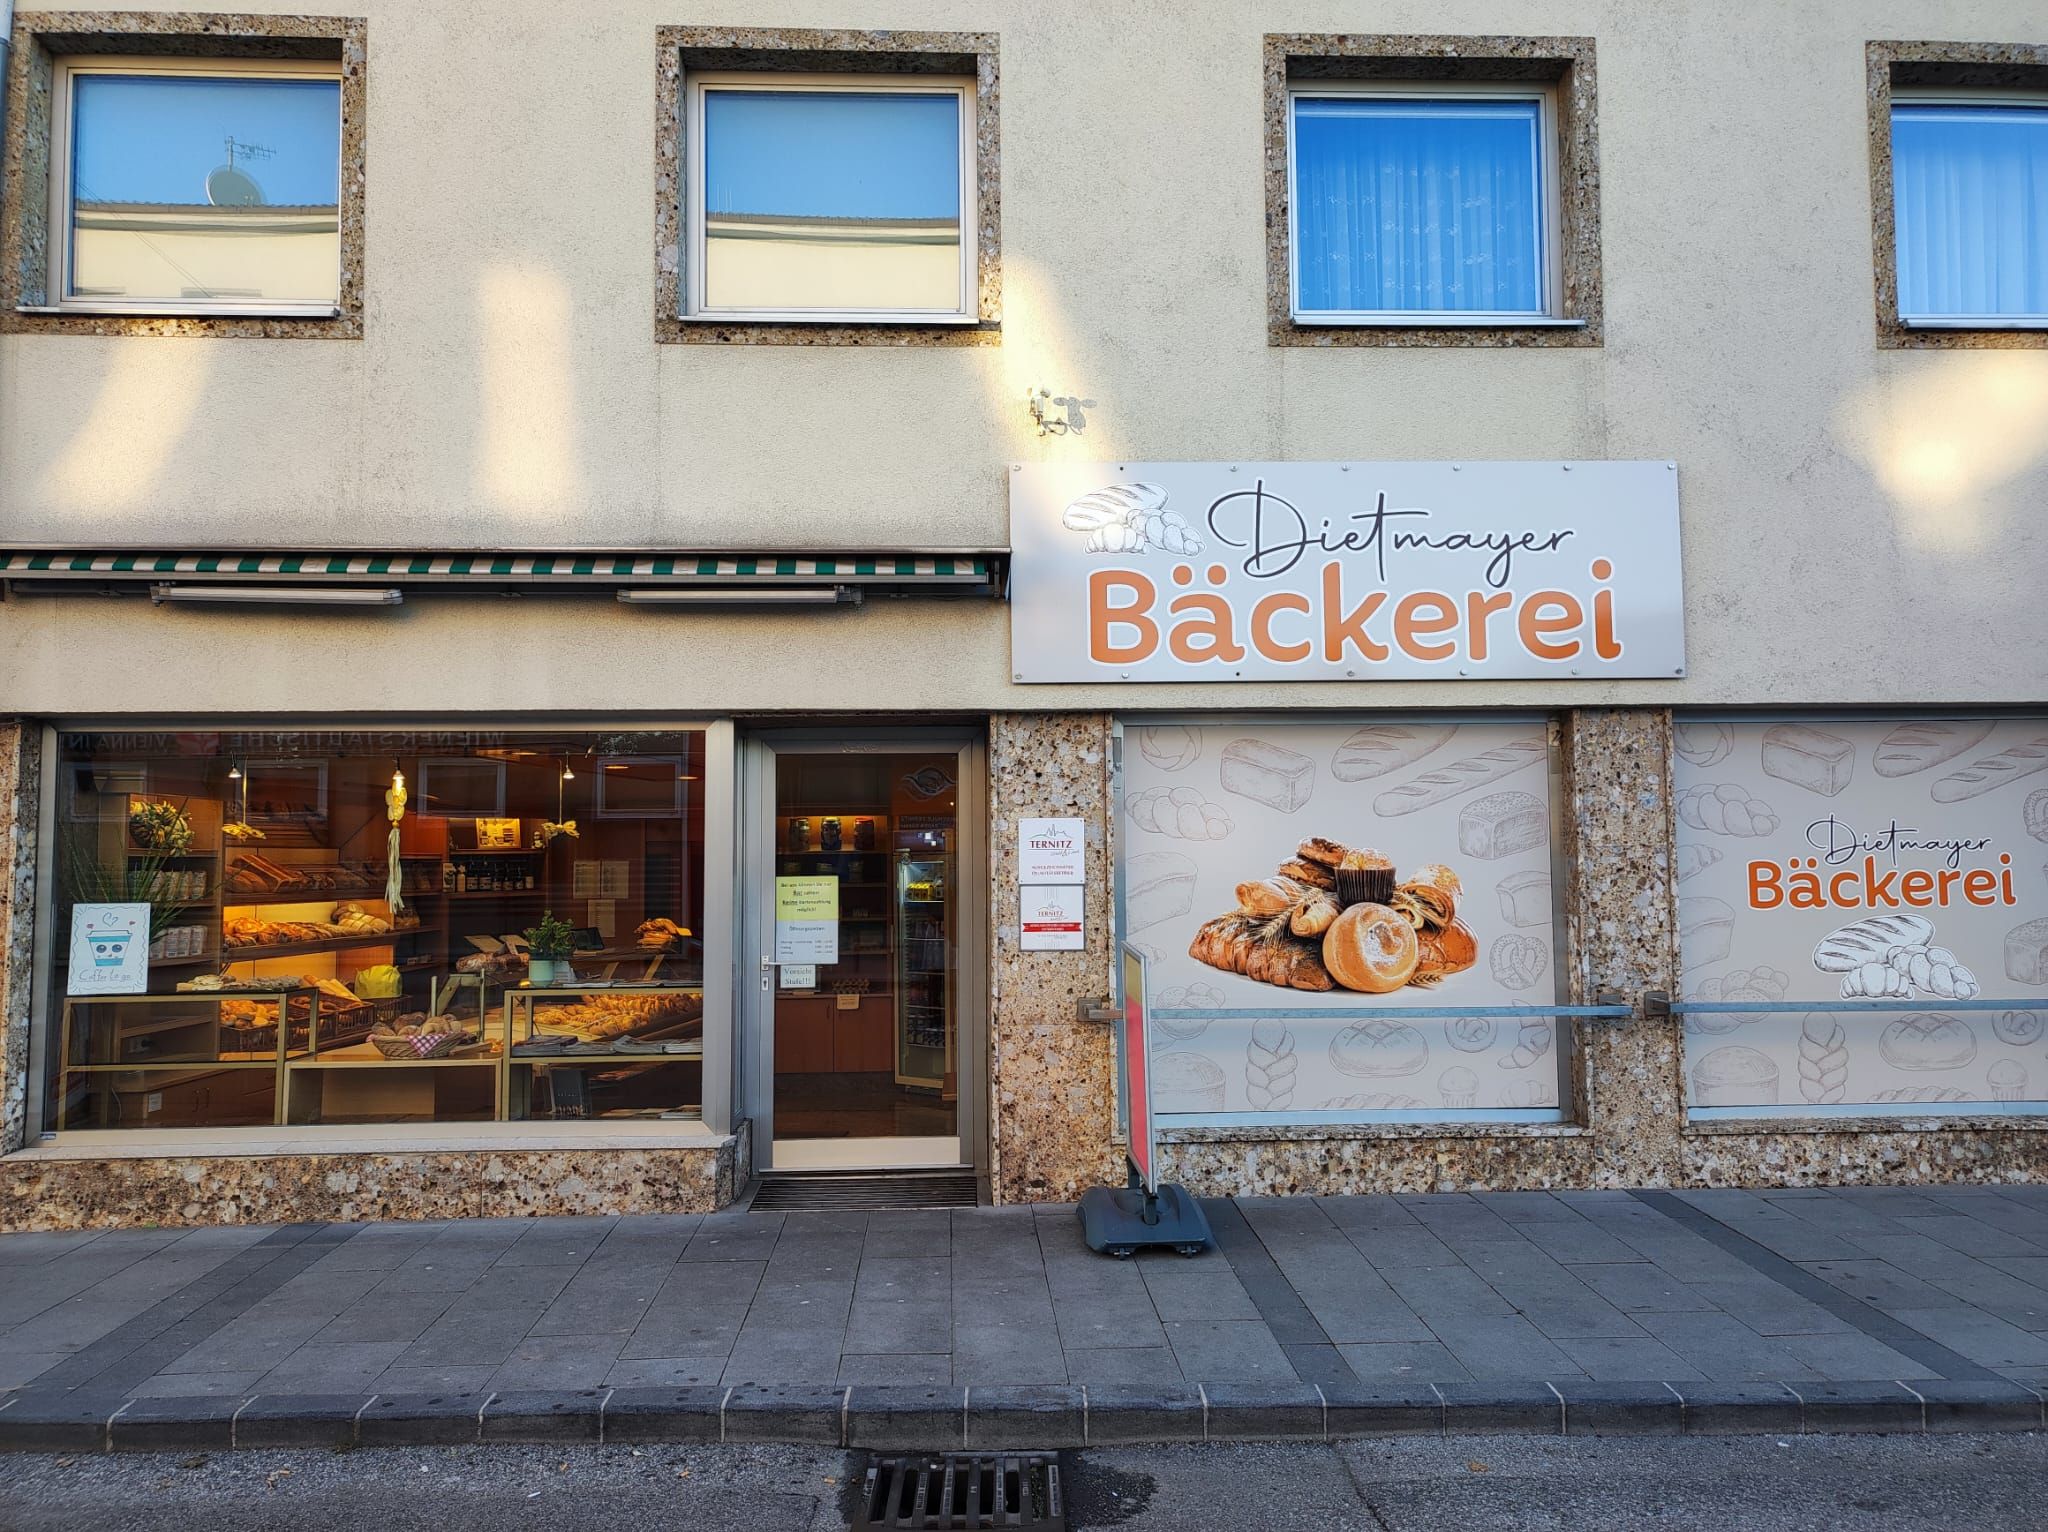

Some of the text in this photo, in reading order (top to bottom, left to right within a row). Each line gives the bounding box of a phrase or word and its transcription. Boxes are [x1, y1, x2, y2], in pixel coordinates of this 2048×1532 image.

[1207, 480, 1574, 588] Dietmayer
[1088, 559, 1623, 664] Bäckerei
[1029, 840, 1073, 849] TERNITZ
[1806, 814, 1992, 868] Dietmayer
[1748, 853, 2017, 909] Bäckerei
